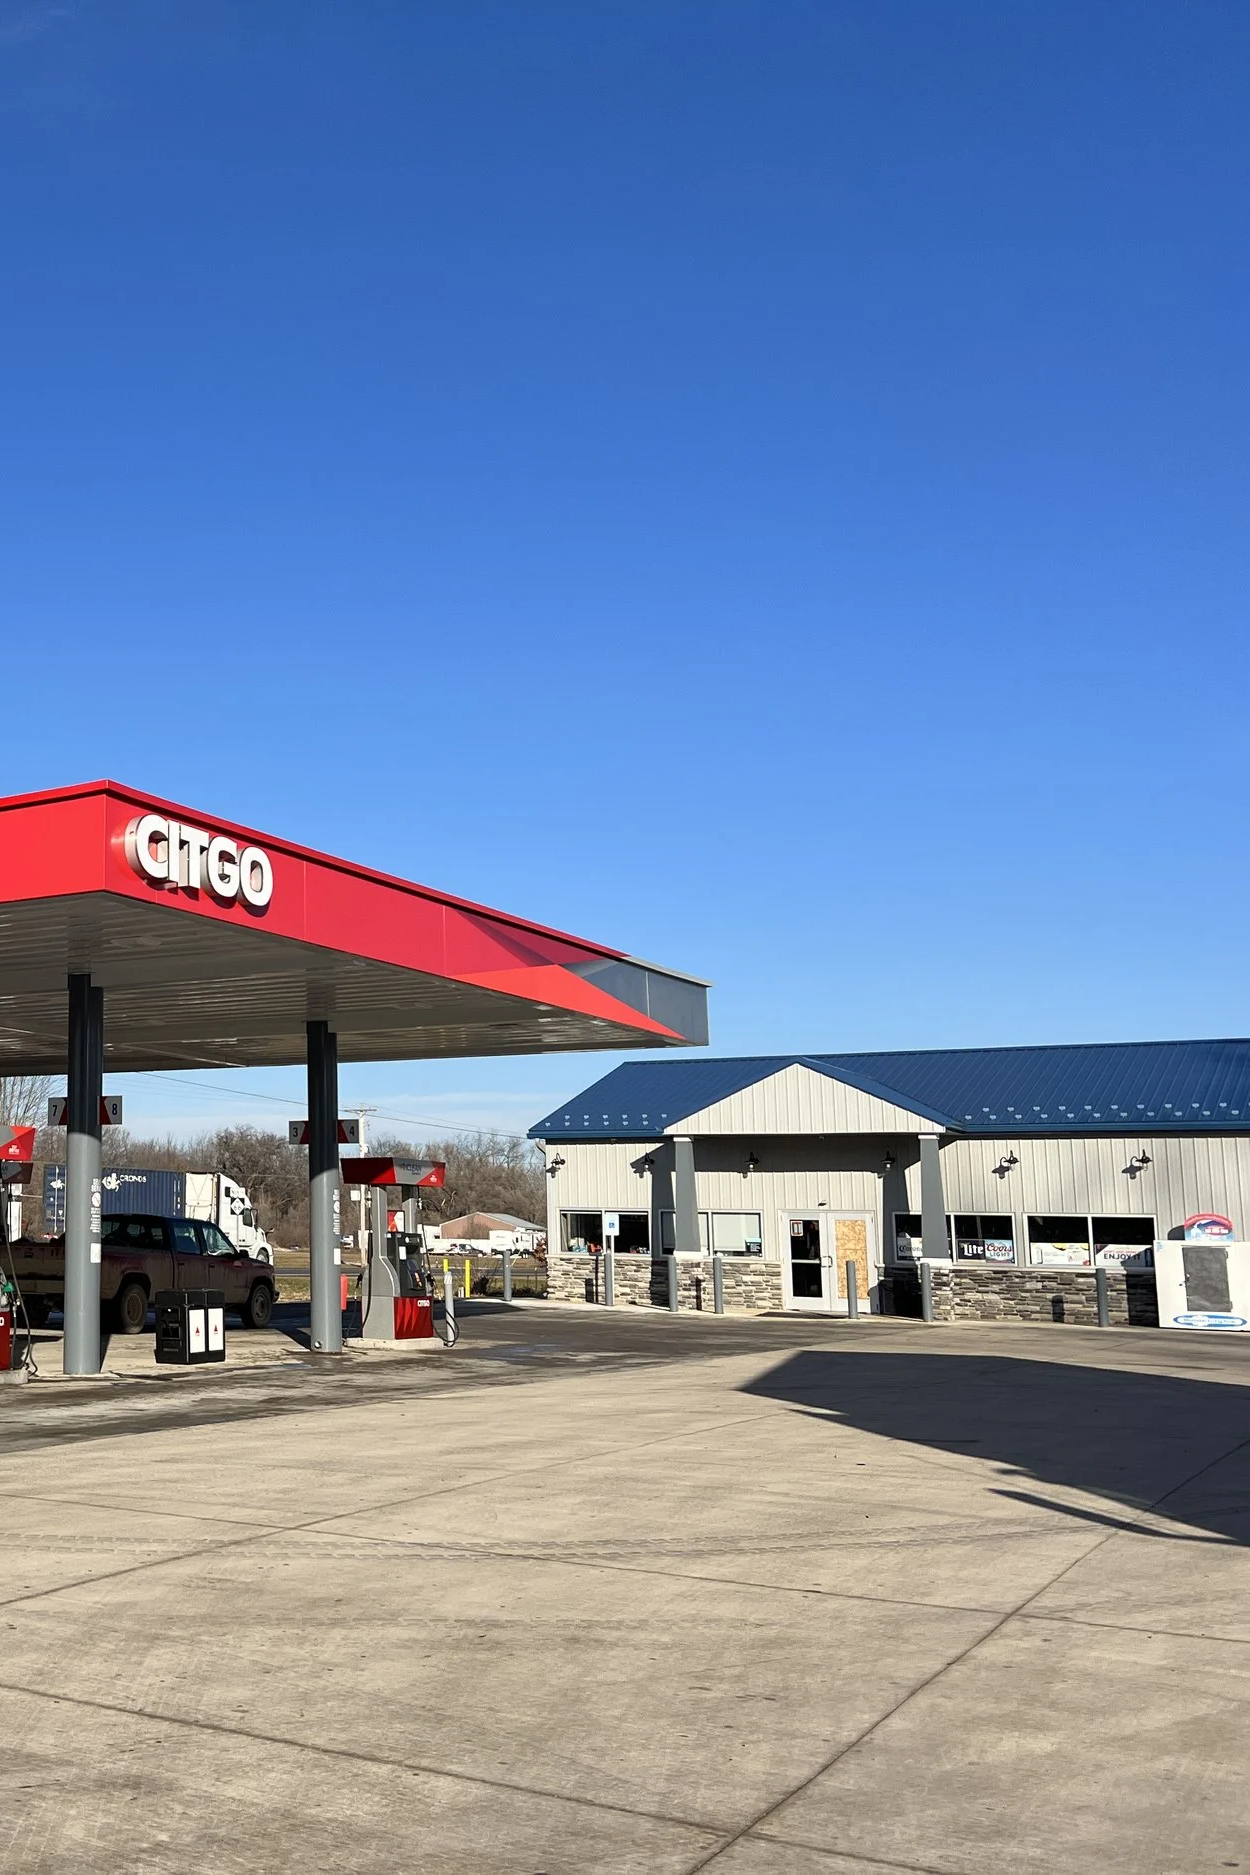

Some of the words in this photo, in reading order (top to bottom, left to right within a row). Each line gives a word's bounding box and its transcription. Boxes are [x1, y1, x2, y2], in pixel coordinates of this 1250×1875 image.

[133, 814, 273, 907] CITGO
[52, 1105, 58, 1116] 7
[112, 1104, 118, 1115] 8
[293, 1127, 299, 1138] 3
[349, 1126, 355, 1136] 4
[963, 1244, 984, 1256] Lite
[986, 1242, 1012, 1252] Coors
